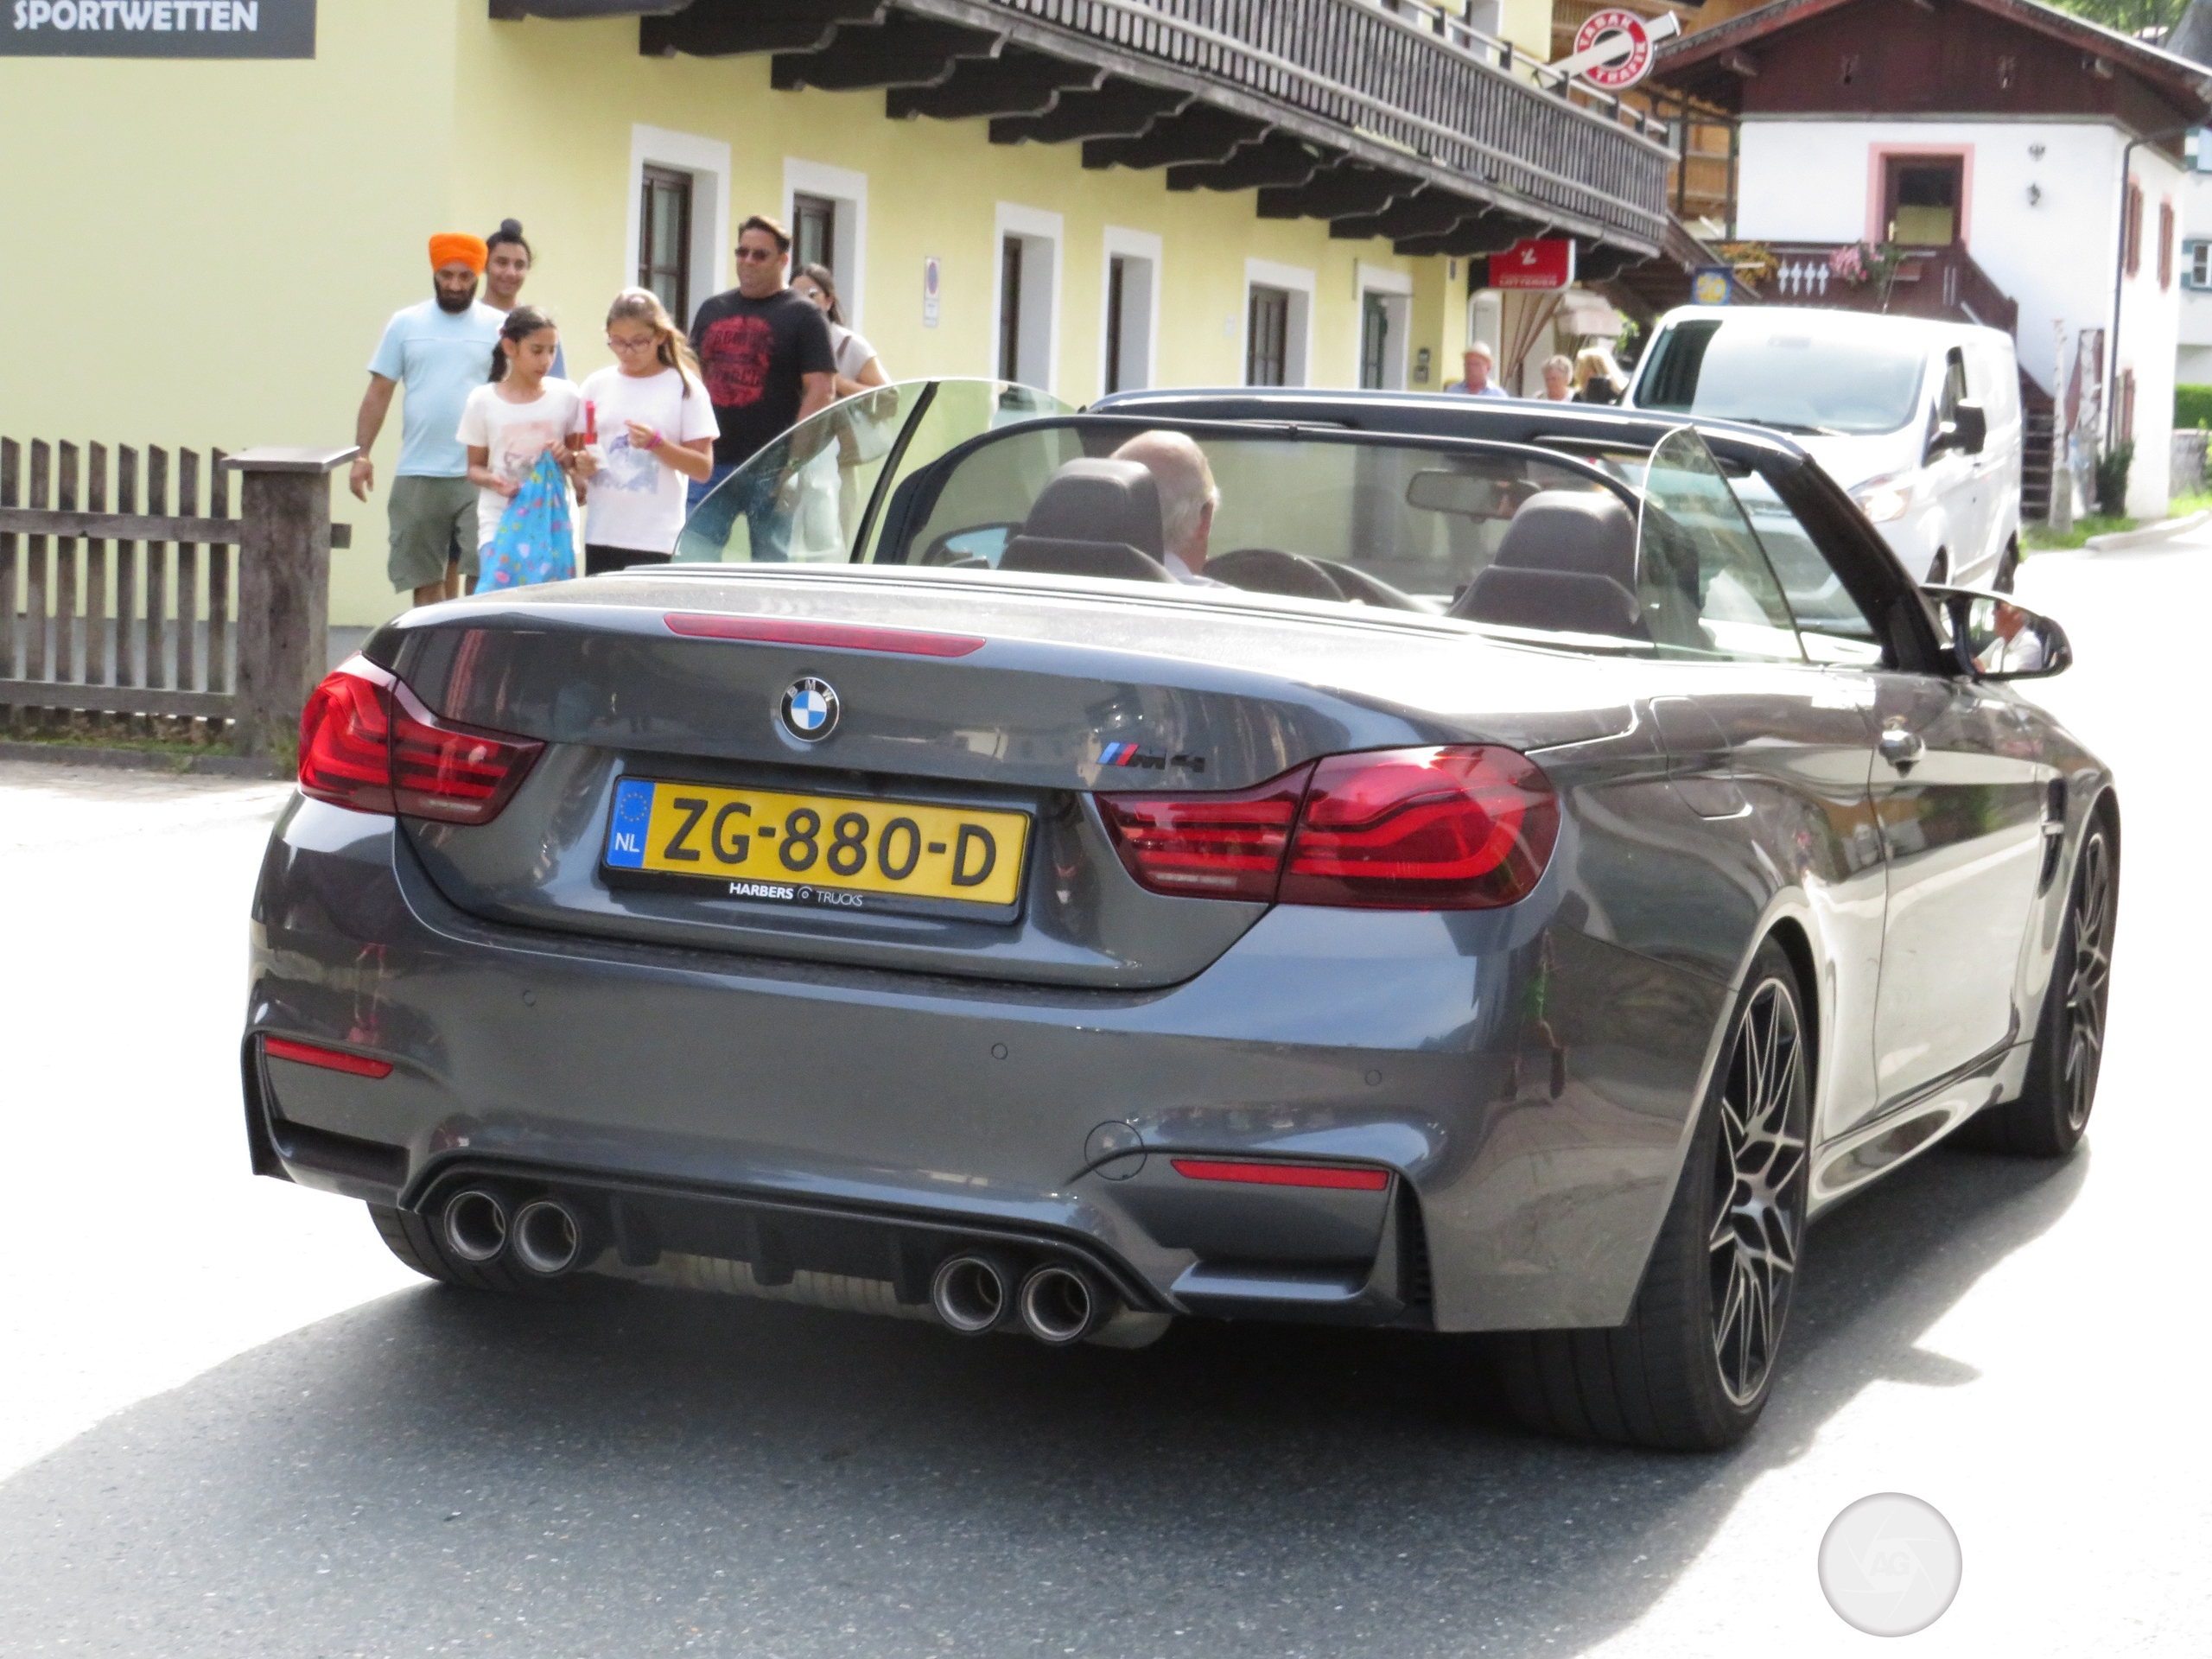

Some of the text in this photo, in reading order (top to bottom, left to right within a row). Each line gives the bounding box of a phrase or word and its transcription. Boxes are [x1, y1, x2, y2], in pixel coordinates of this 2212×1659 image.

[13, 0, 258, 31] SPORTWETTEN
[1578, 12, 1632, 47] TABAK
[1596, 41, 1646, 83] TRAFIK
[786, 678, 835, 702] BMW
[614, 832, 640, 854] NL
[663, 797, 997, 887] ZG-880-D
[729, 881, 863, 907] HARBERS TRUCKS
